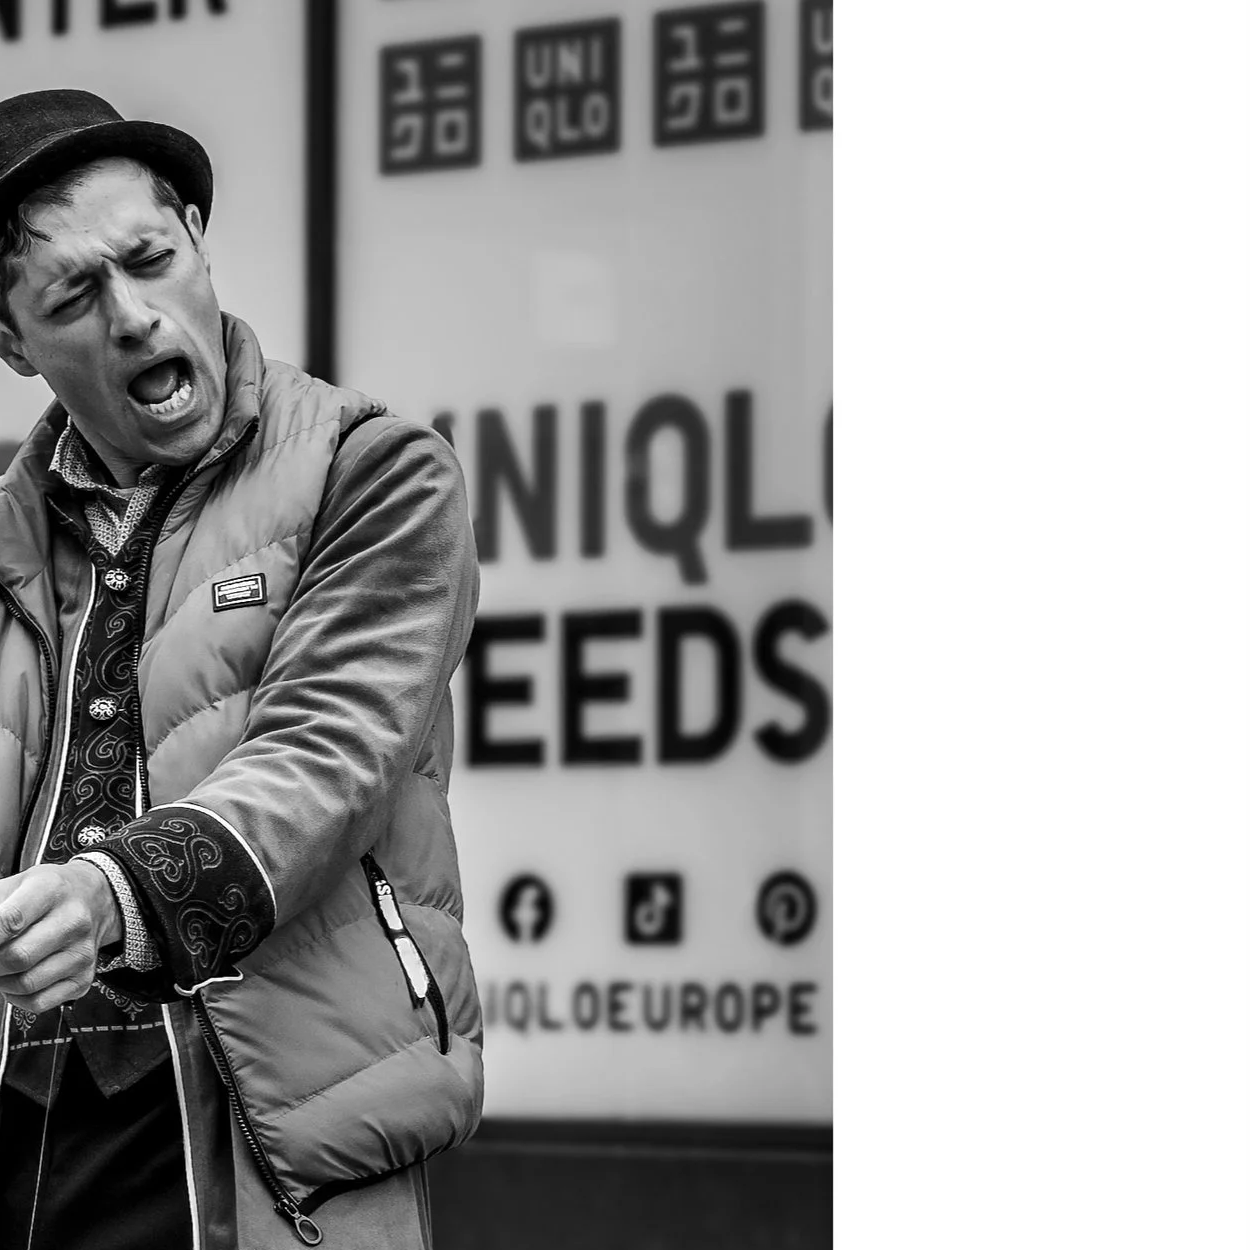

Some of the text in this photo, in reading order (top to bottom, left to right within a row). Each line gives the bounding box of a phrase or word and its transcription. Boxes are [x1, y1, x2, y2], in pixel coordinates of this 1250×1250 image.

[523, 34, 604, 88] UNI
[524, 92, 610, 148] QLO
[433, 389, 833, 586] NIQL
